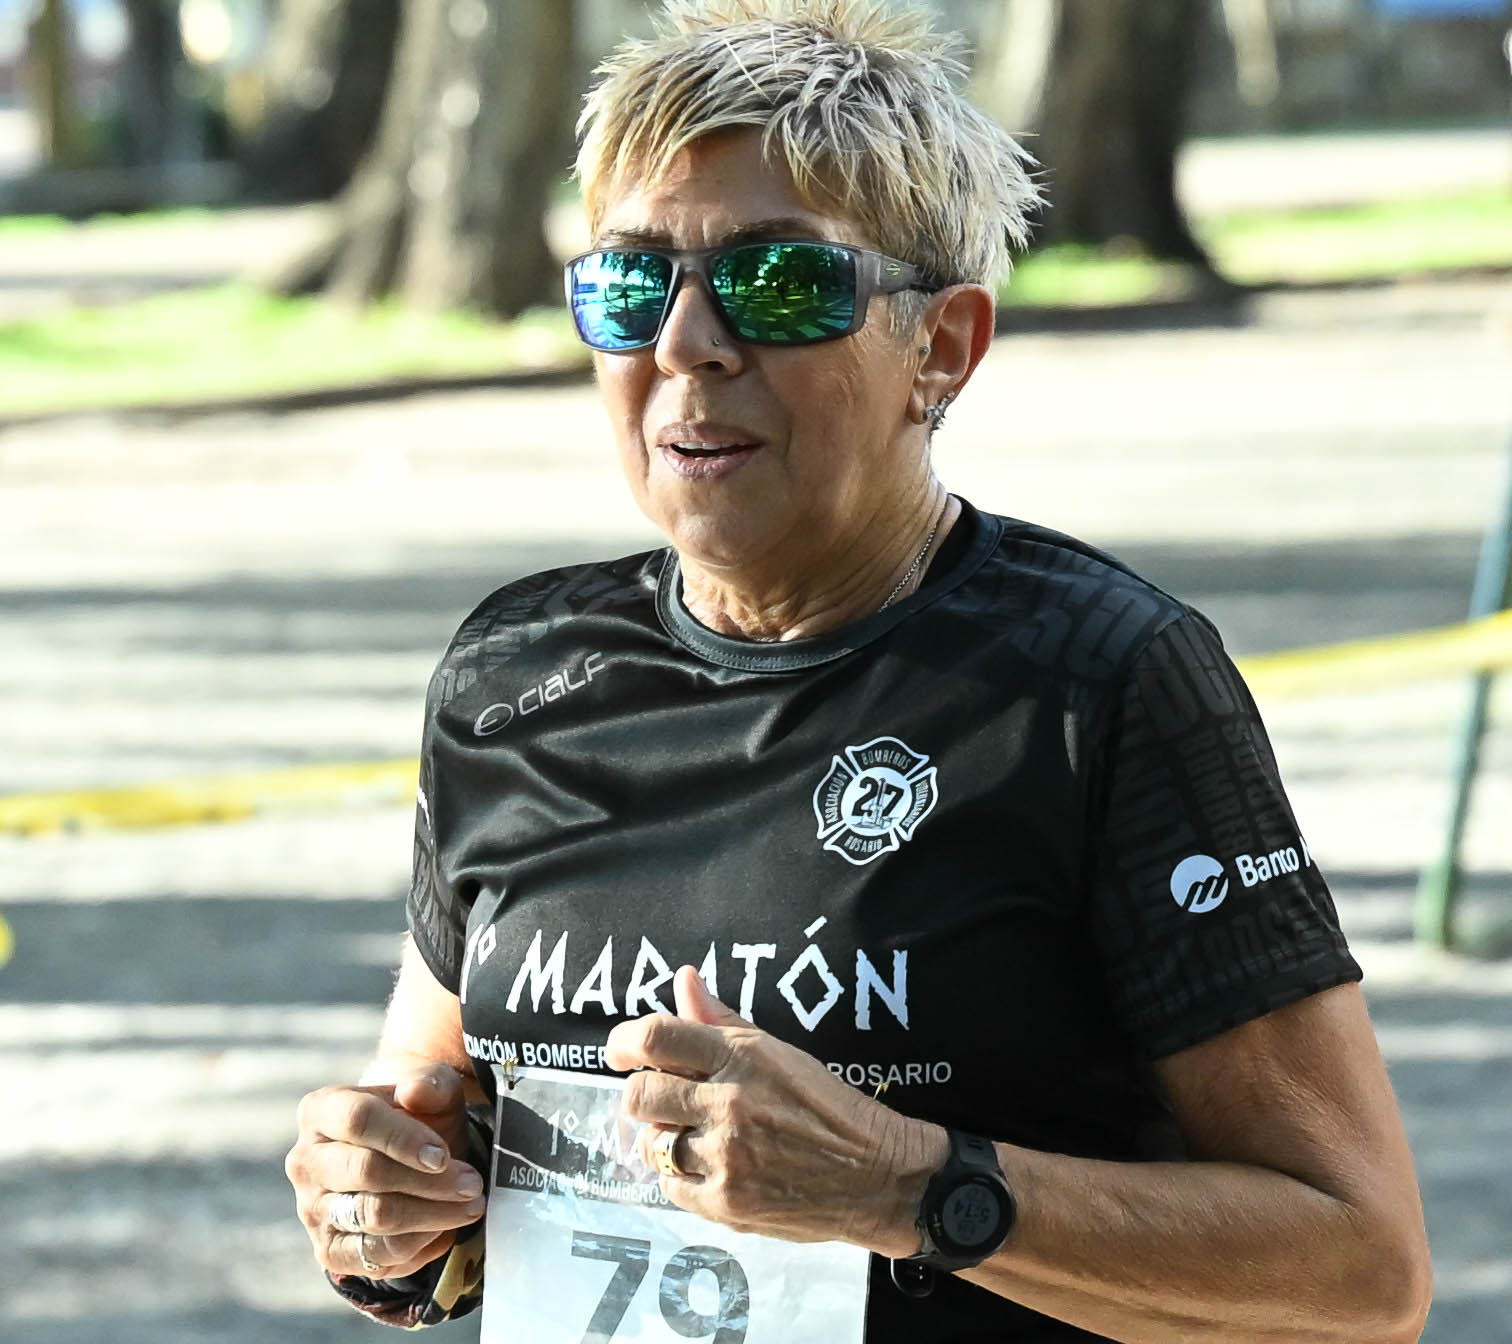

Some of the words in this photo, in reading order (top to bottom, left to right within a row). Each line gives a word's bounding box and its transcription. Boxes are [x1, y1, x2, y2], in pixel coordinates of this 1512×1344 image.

[862, 749, 913, 770] BOMBEROS
[851, 776, 905, 817] 27
[844, 835, 883, 853] ROSARIO
[1235, 846, 1300, 888] Banco
[506, 916, 909, 1031] MARATÓN
[522, 1042, 610, 1069] BOMBER
[826, 1061, 952, 1087] ROSARIO
[591, 1177, 671, 1206] BOMBEROS
